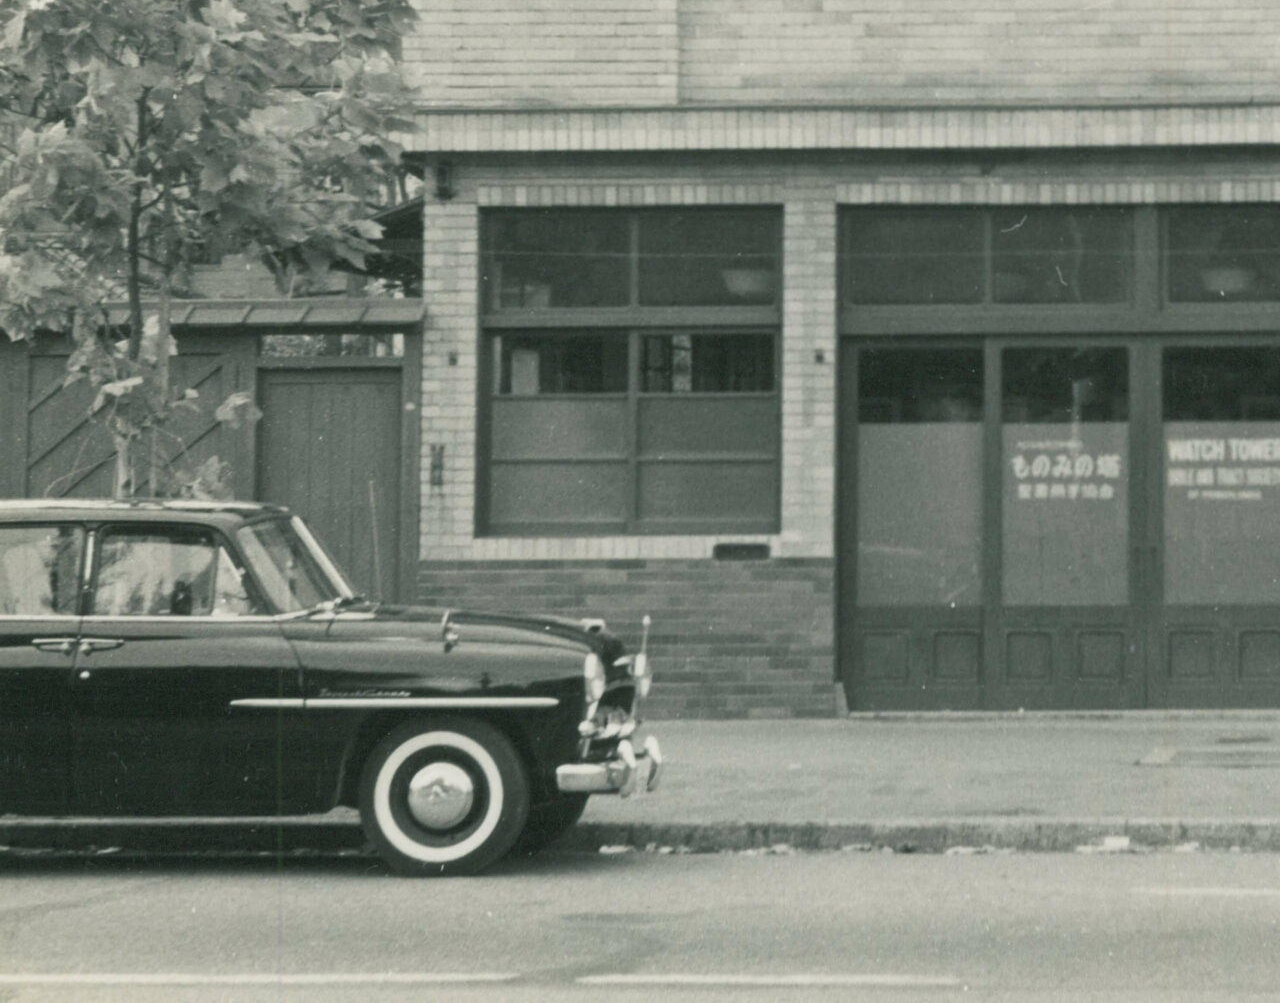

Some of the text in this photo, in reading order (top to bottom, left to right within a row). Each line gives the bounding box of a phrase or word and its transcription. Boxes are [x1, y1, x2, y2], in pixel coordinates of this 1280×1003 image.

[1169, 439, 1225, 461] WATCH
[1012, 454, 1120, 478] ものみの塔
